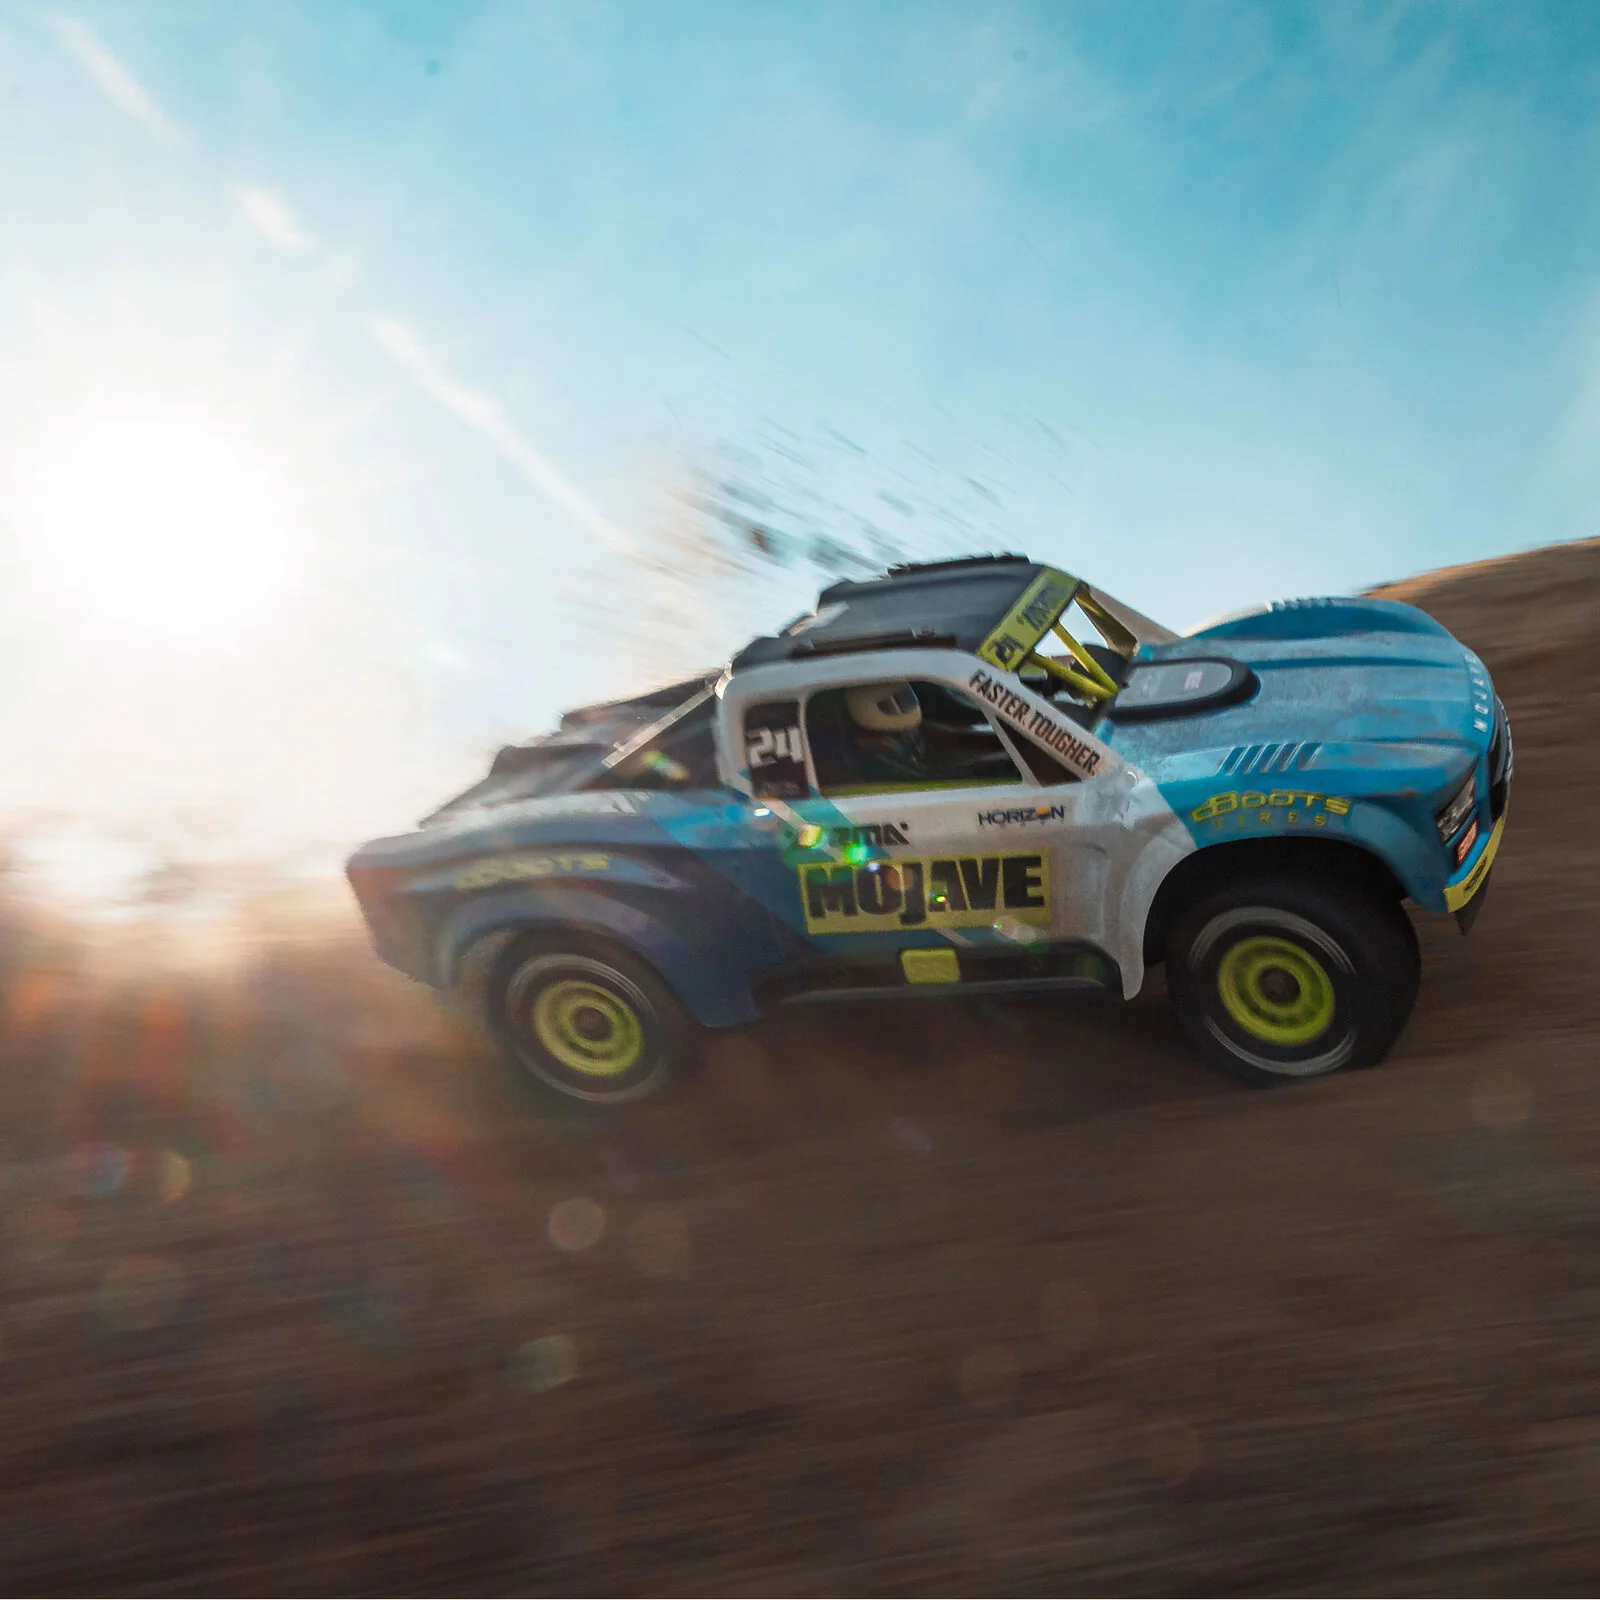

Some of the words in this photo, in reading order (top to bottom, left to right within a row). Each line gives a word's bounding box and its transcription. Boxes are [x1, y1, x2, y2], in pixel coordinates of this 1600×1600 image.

[969, 668, 1026, 725] FASTER.
[1030, 711, 1101, 777] TOUGHER.
[746, 726, 804, 768] 24
[977, 804, 1065, 825] HORIZON
[1214, 810, 1328, 832] TIRES
[807, 855, 1045, 925] MOJAVE
